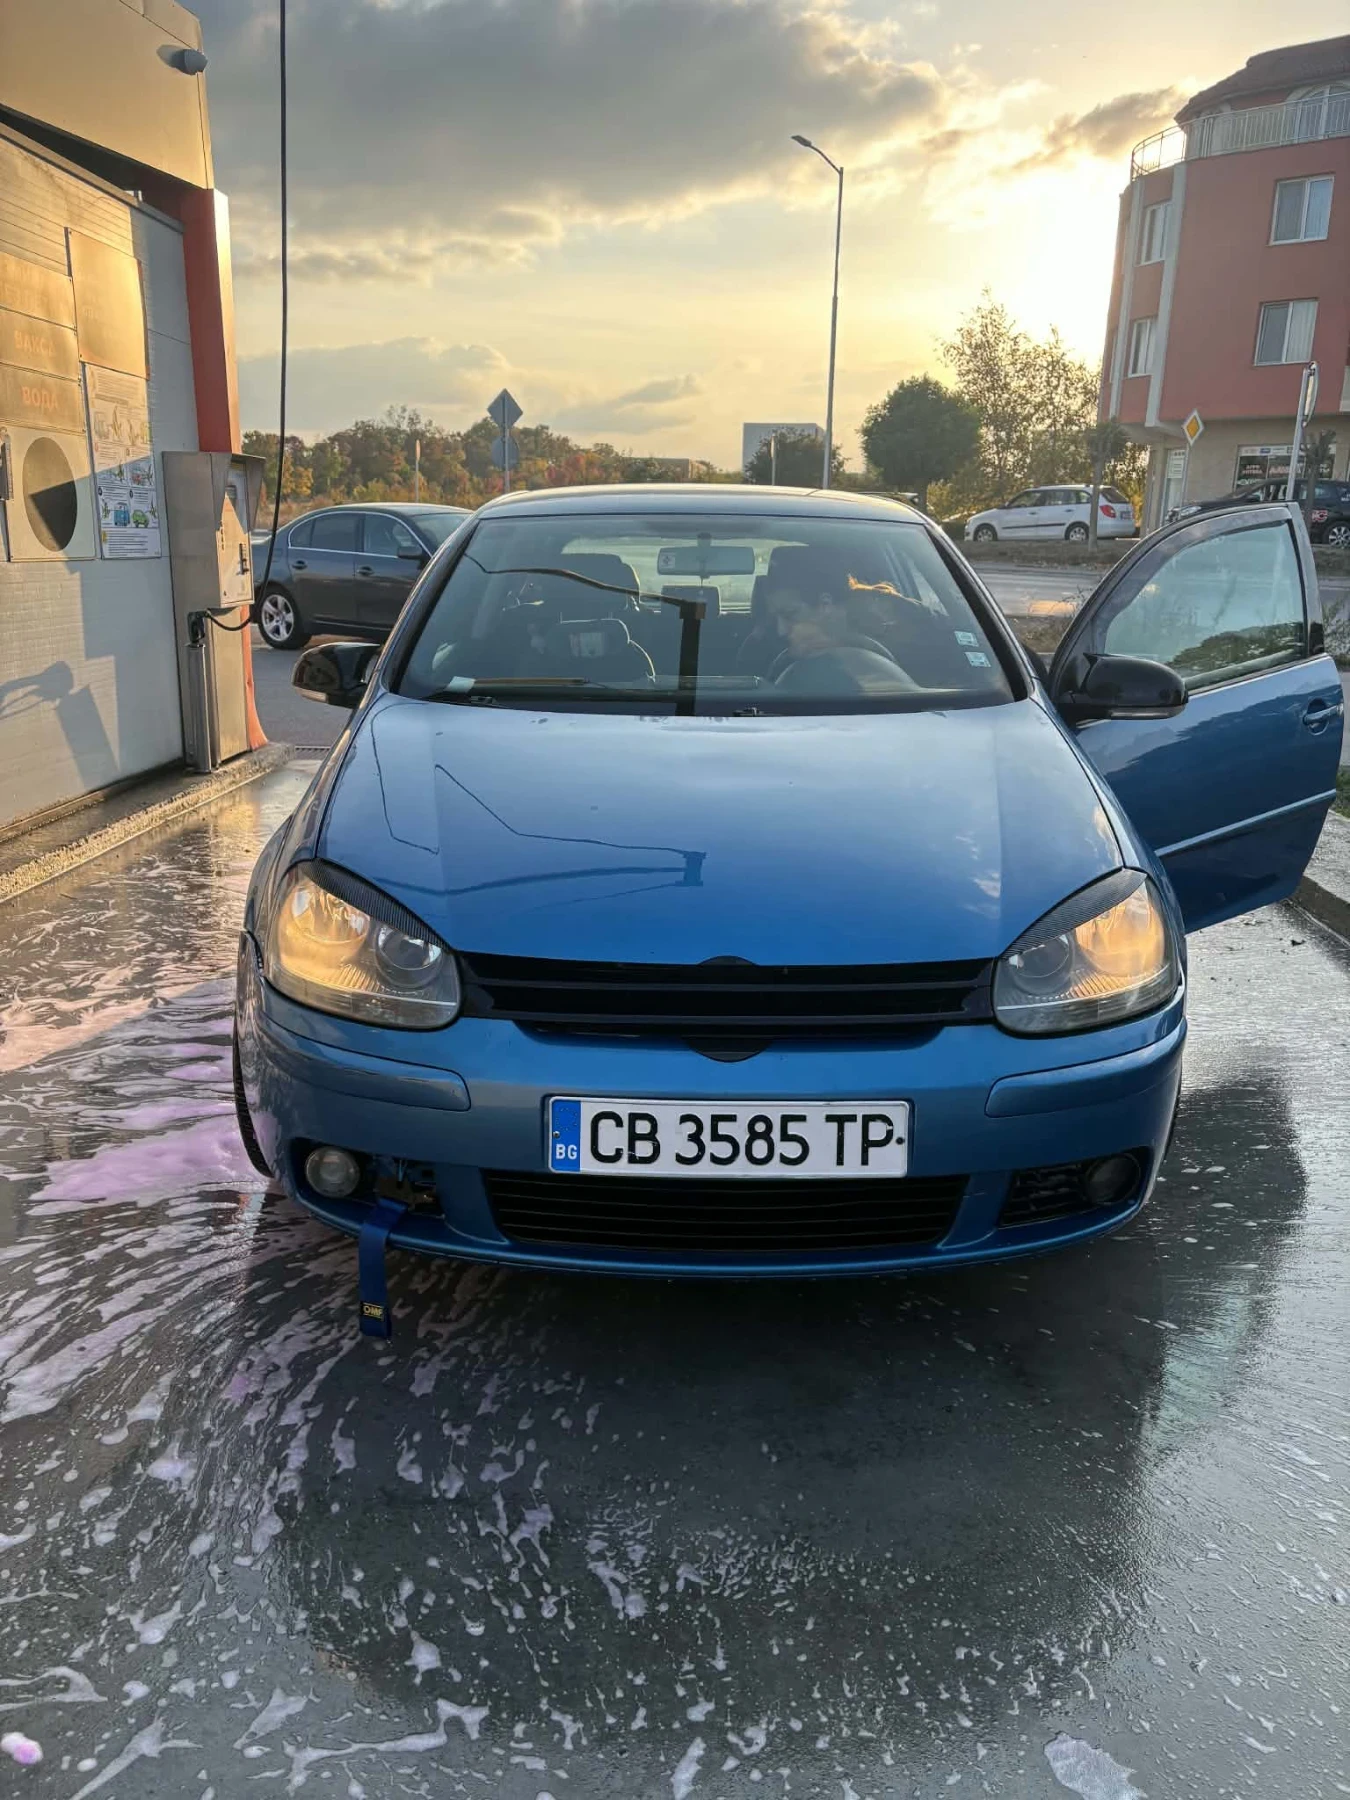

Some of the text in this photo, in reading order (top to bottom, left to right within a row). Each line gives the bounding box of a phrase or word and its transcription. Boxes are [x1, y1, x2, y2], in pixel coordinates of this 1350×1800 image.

[22, 386, 57, 411] ВОДА
[590, 1110, 894, 1166] CB 3585 TP
[555, 1144, 578, 1159] BG
